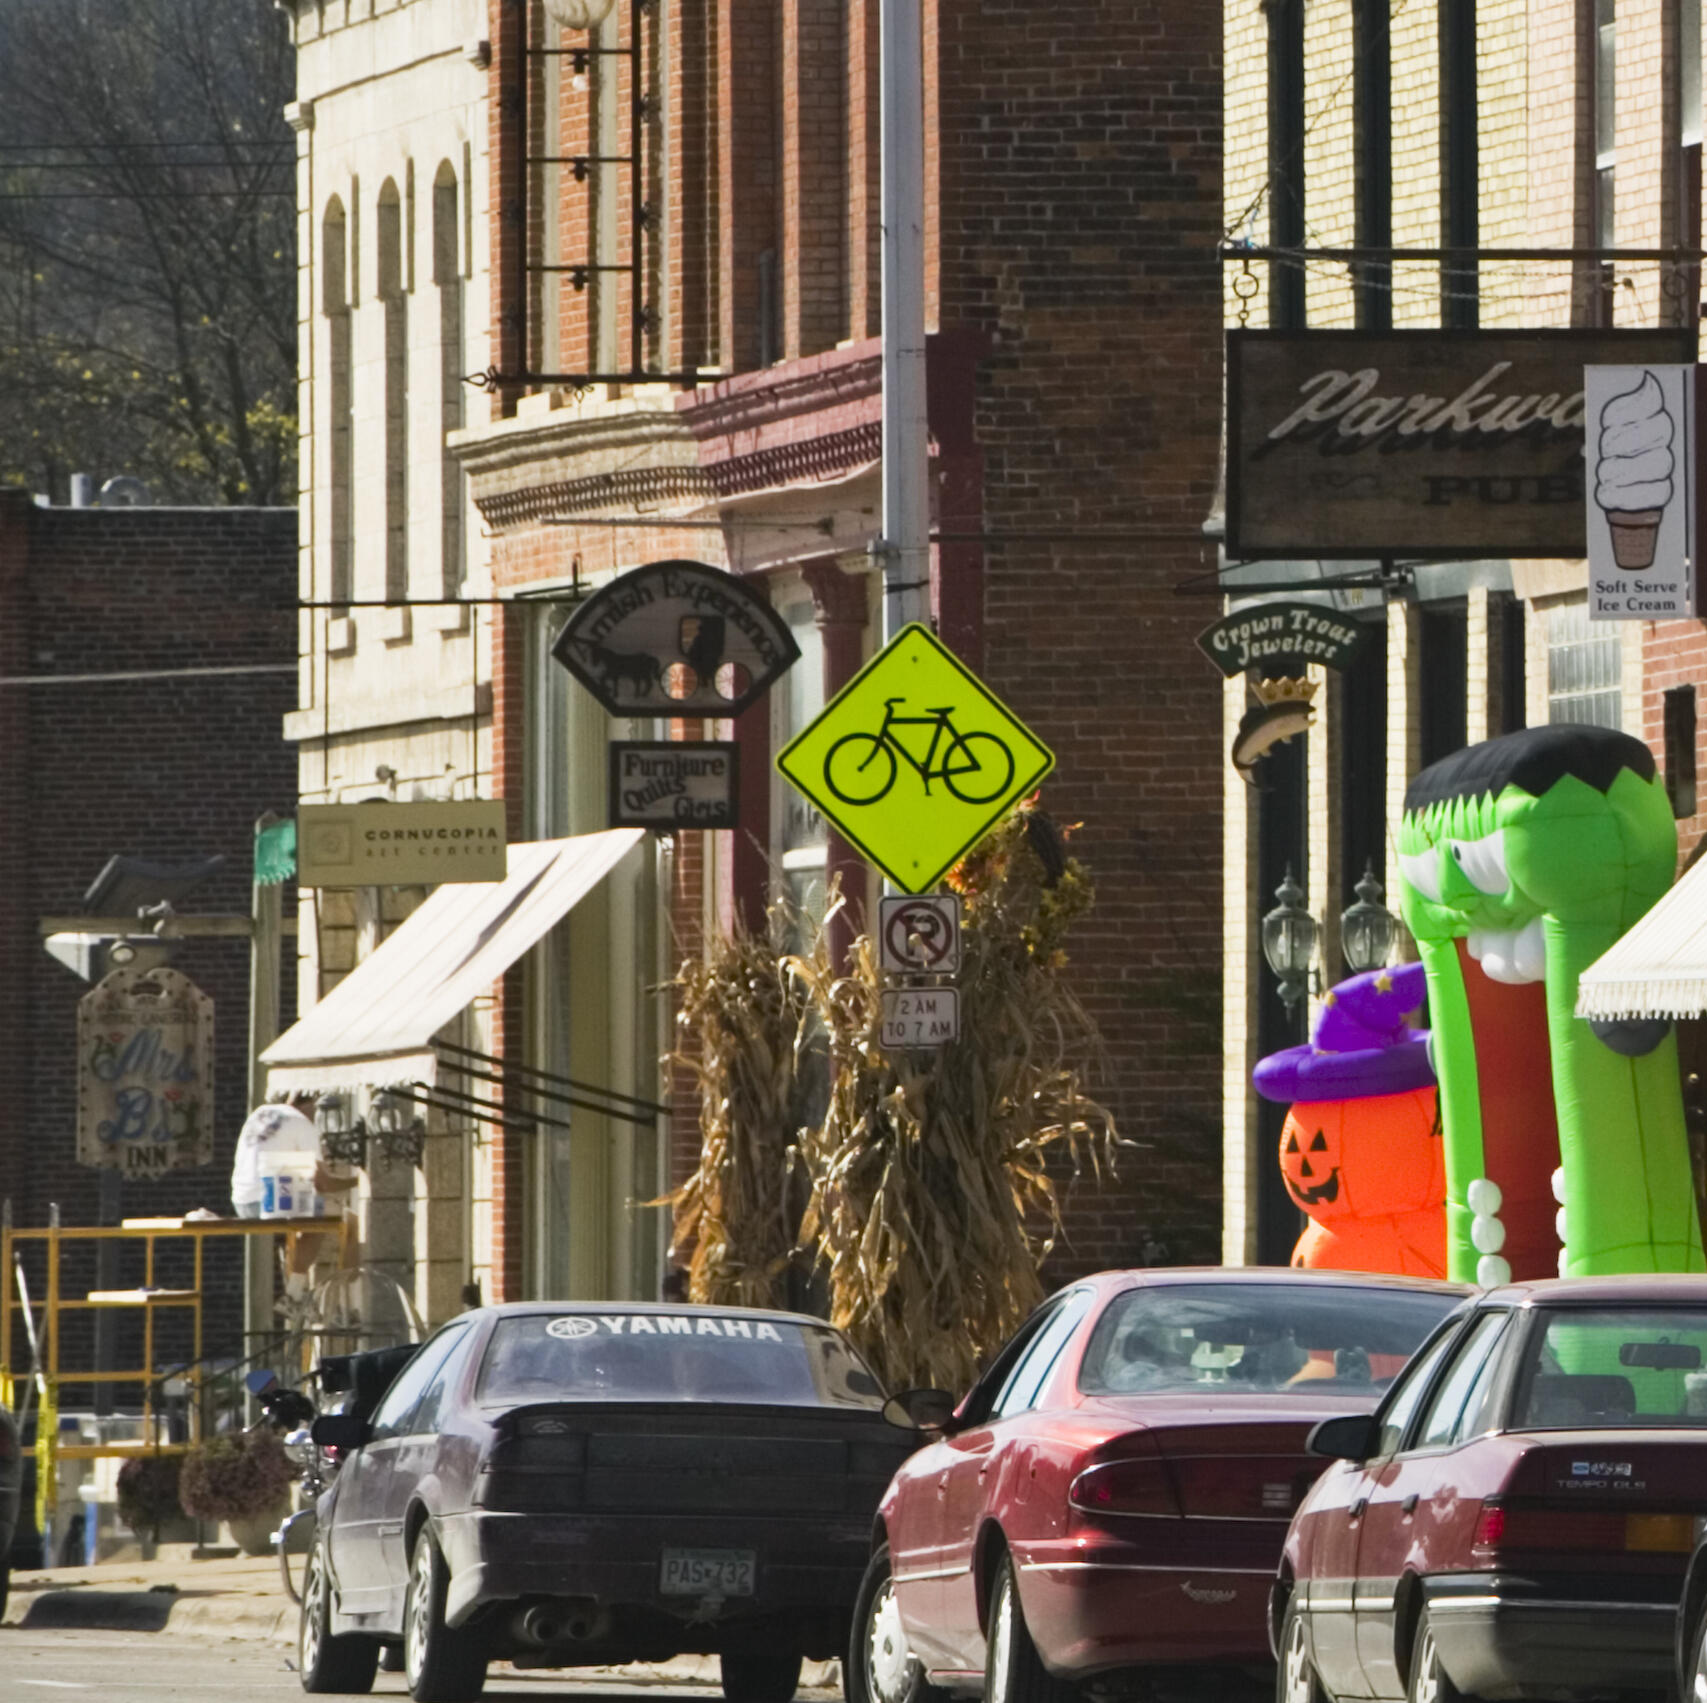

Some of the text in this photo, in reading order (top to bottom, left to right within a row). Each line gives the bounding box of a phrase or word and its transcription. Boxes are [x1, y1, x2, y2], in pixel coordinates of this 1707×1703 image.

[1268, 361, 1585, 439] Parkwa
[1424, 475, 1584, 506] PUB
[1595, 579, 1677, 595] Soft Serve
[1598, 598, 1676, 613] Ice Cream
[565, 571, 782, 668] Amish Experience
[1212, 609, 1358, 652] Crown Trout
[1237, 633, 1337, 665] Jewelers
[624, 753, 725, 776] Furniture
[623, 777, 686, 812] Quilts
[364, 827, 499, 842] CORNUCOPIA
[420, 846, 498, 857] center
[901, 999, 937, 1016] 2 AM
[888, 1022, 952, 1038] TO 7 AM
[127, 1147, 168, 1168] INN
[600, 1316, 784, 1343] YAMAHA
[668, 1560, 704, 1584] PAS
